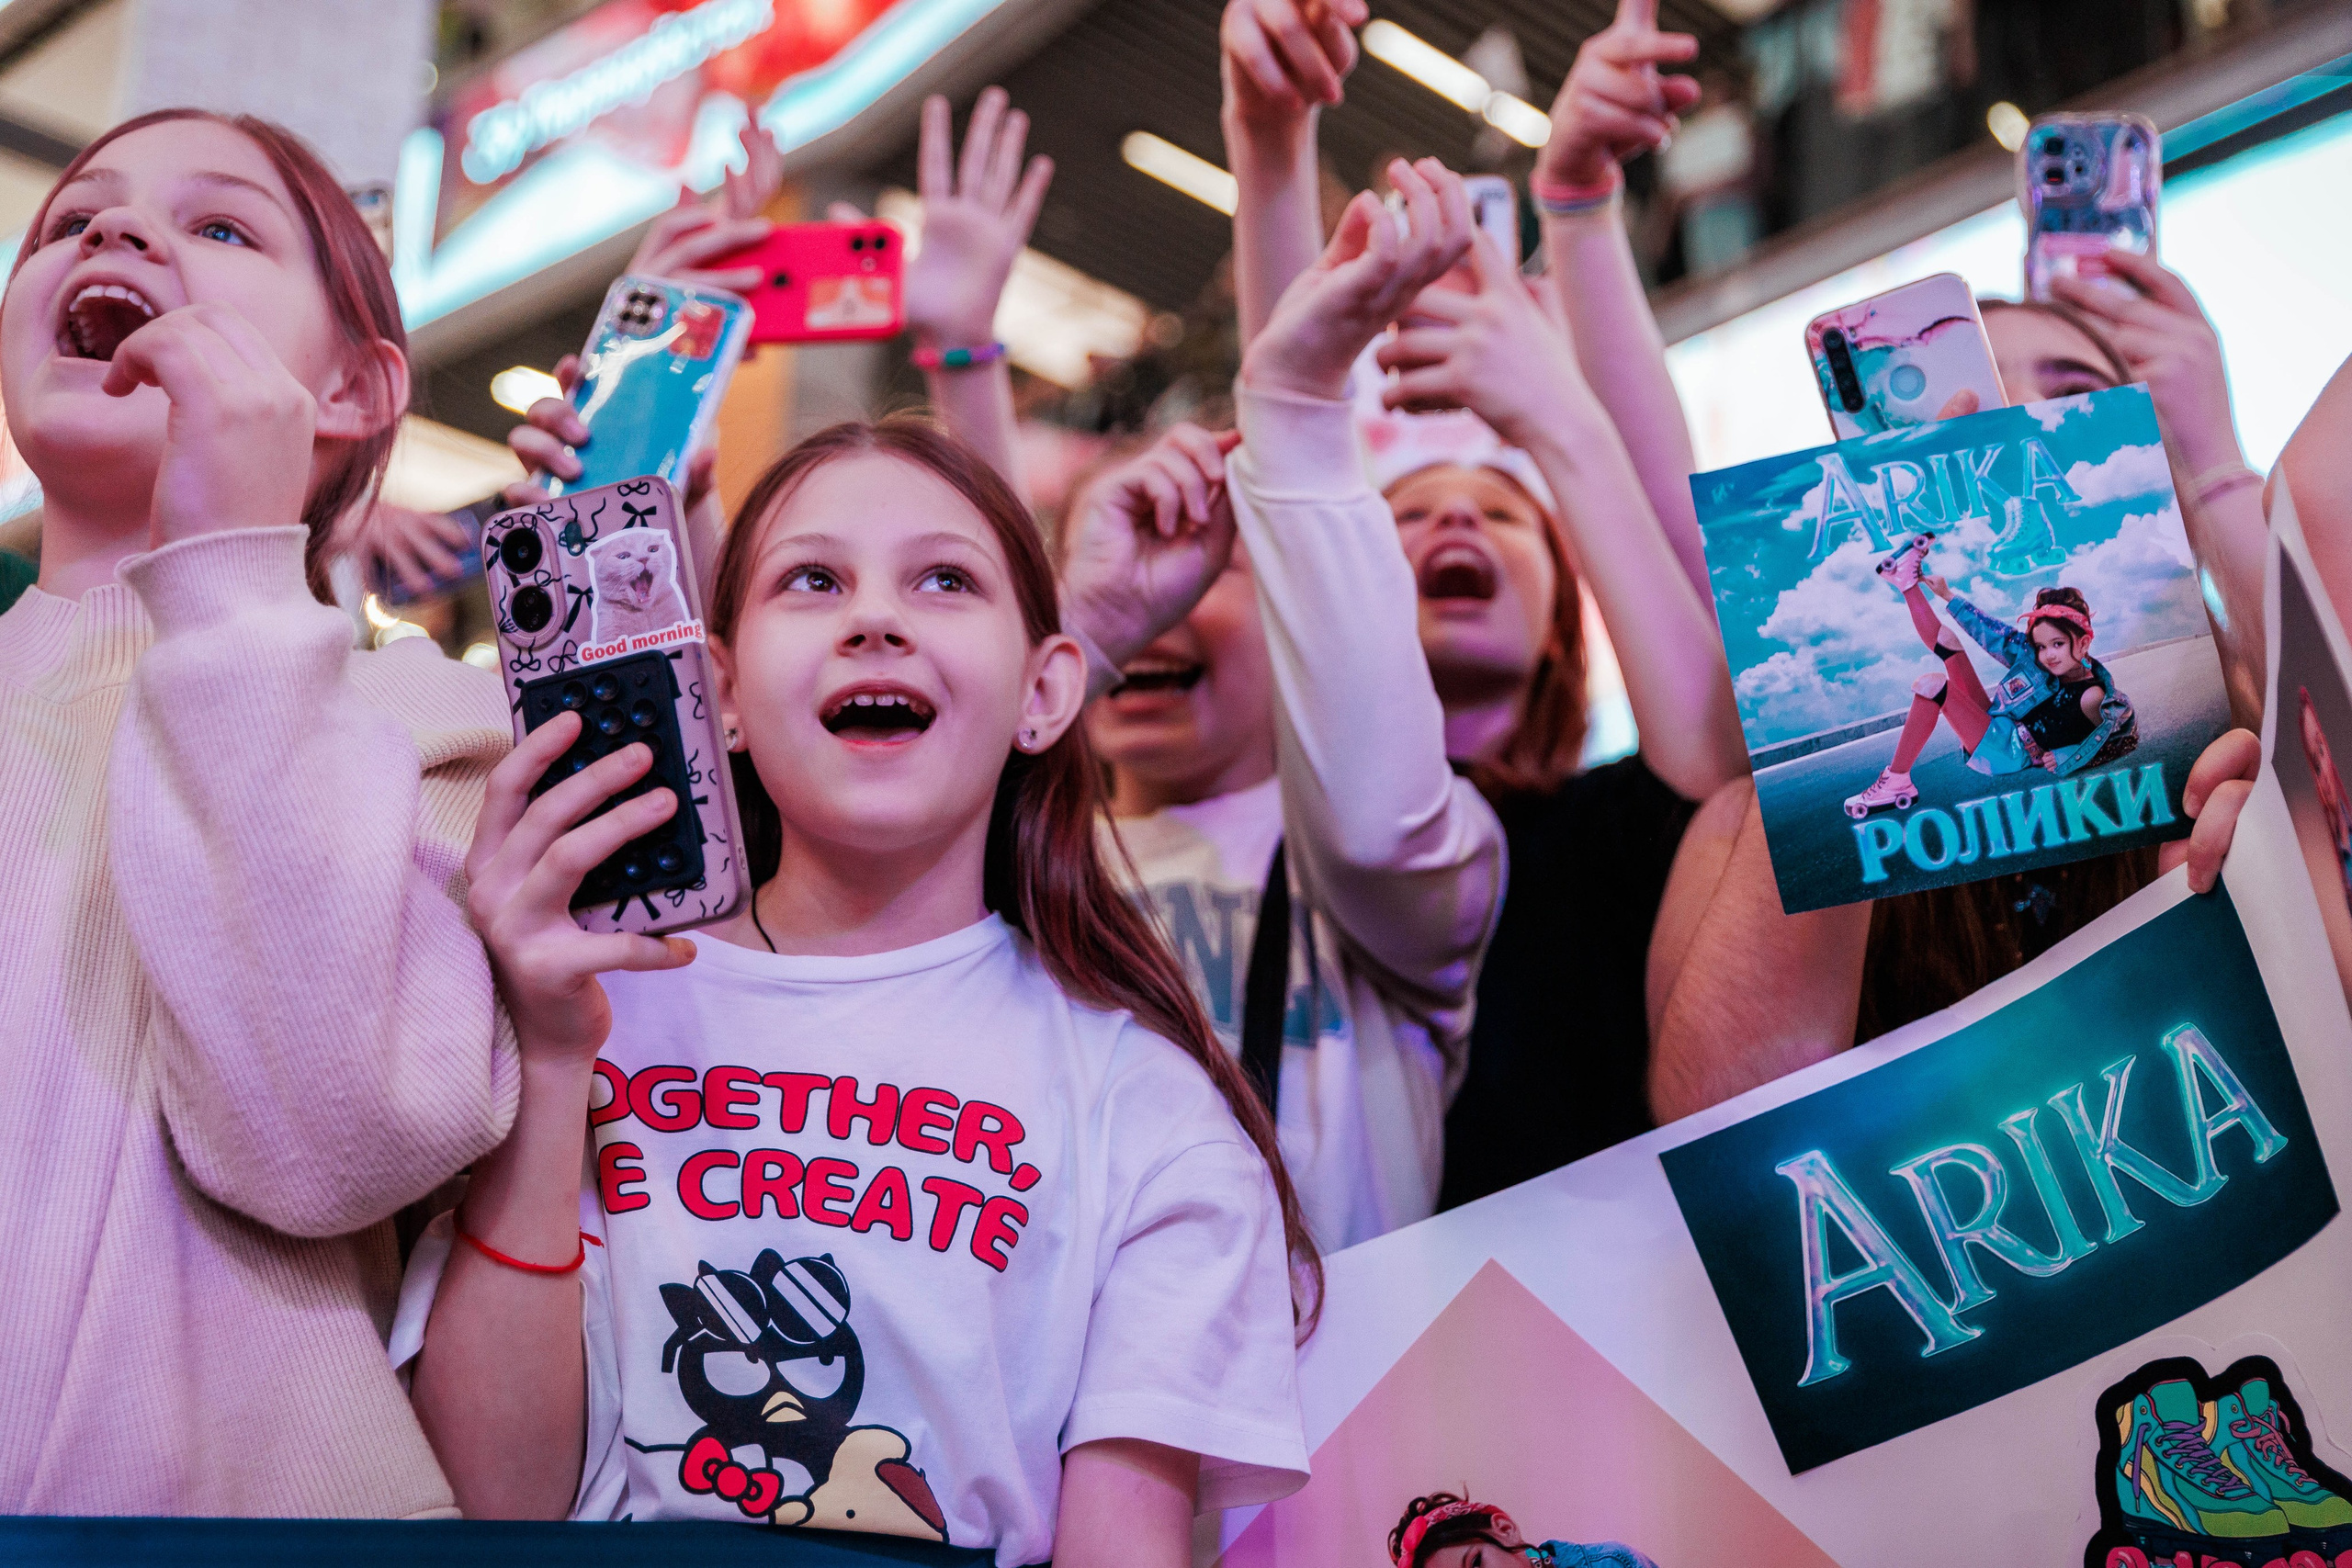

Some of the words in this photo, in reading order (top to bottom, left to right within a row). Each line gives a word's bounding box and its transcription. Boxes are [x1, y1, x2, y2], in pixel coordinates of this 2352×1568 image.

[1807, 435, 2083, 560] ARIKA
[582, 638, 628, 661] Good
[632, 624, 703, 650] morning
[1851, 761, 2177, 884] РОЛИКИ
[588, 1057, 1042, 1192] OGETHER,
[598, 1141, 651, 1214] E
[677, 1148, 1029, 1272] CREATE
[1774, 1021, 2289, 1387] ARIKA
